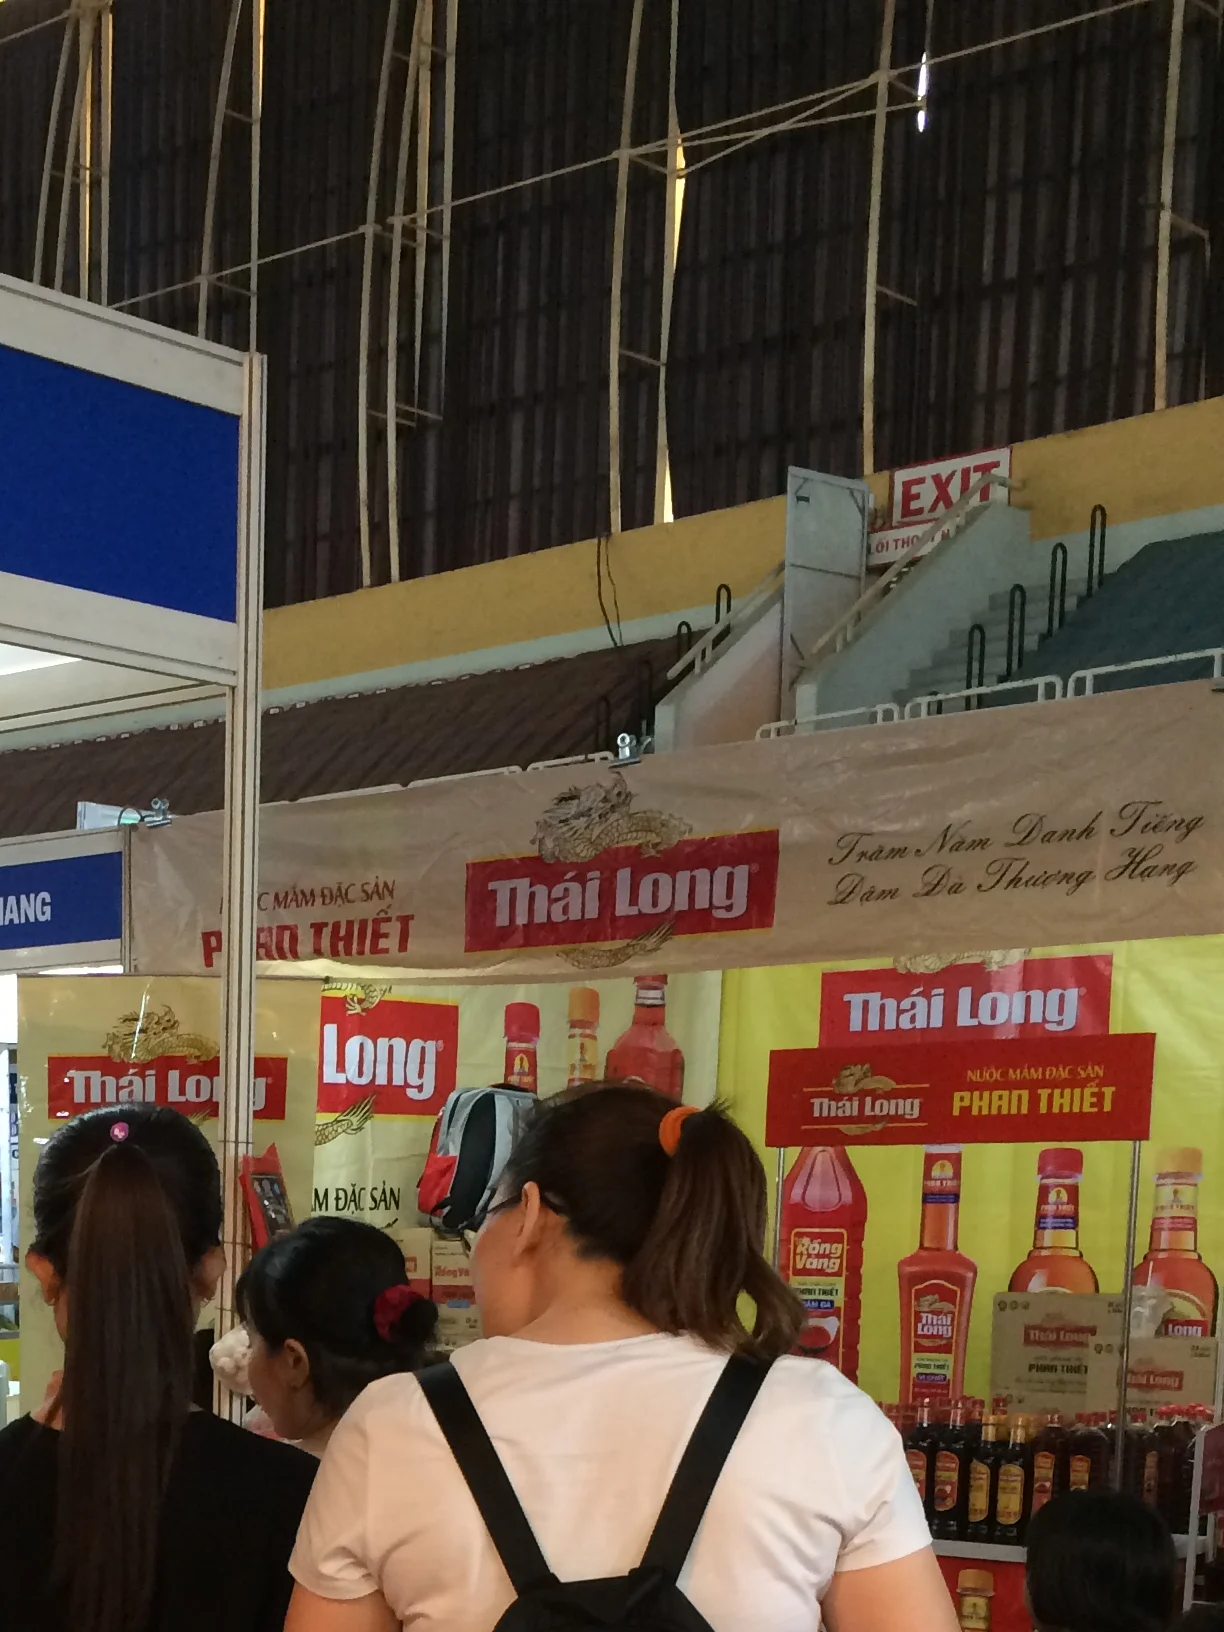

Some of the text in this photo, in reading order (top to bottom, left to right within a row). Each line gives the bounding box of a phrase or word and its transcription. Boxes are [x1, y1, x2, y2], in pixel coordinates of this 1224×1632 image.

[901, 461, 1001, 518] EXIT
[319, 882, 356, 908] ĐẶC
[360, 876, 396, 902] SẢN
[488, 864, 750, 928] Thái Long
[201, 904, 415, 968] PAN THIẾT
[843, 985, 1080, 1033] Thái Long
[323, 1023, 436, 1100] Long
[67, 1067, 156, 1103] Thái
[952, 1079, 1117, 1116] PHAN THIẾT
[811, 1094, 921, 1121] Thái Long
[334, 1182, 364, 1213] ĐẶC
[368, 1179, 401, 1211] SẢN
[917, 1323, 952, 1338] Long
